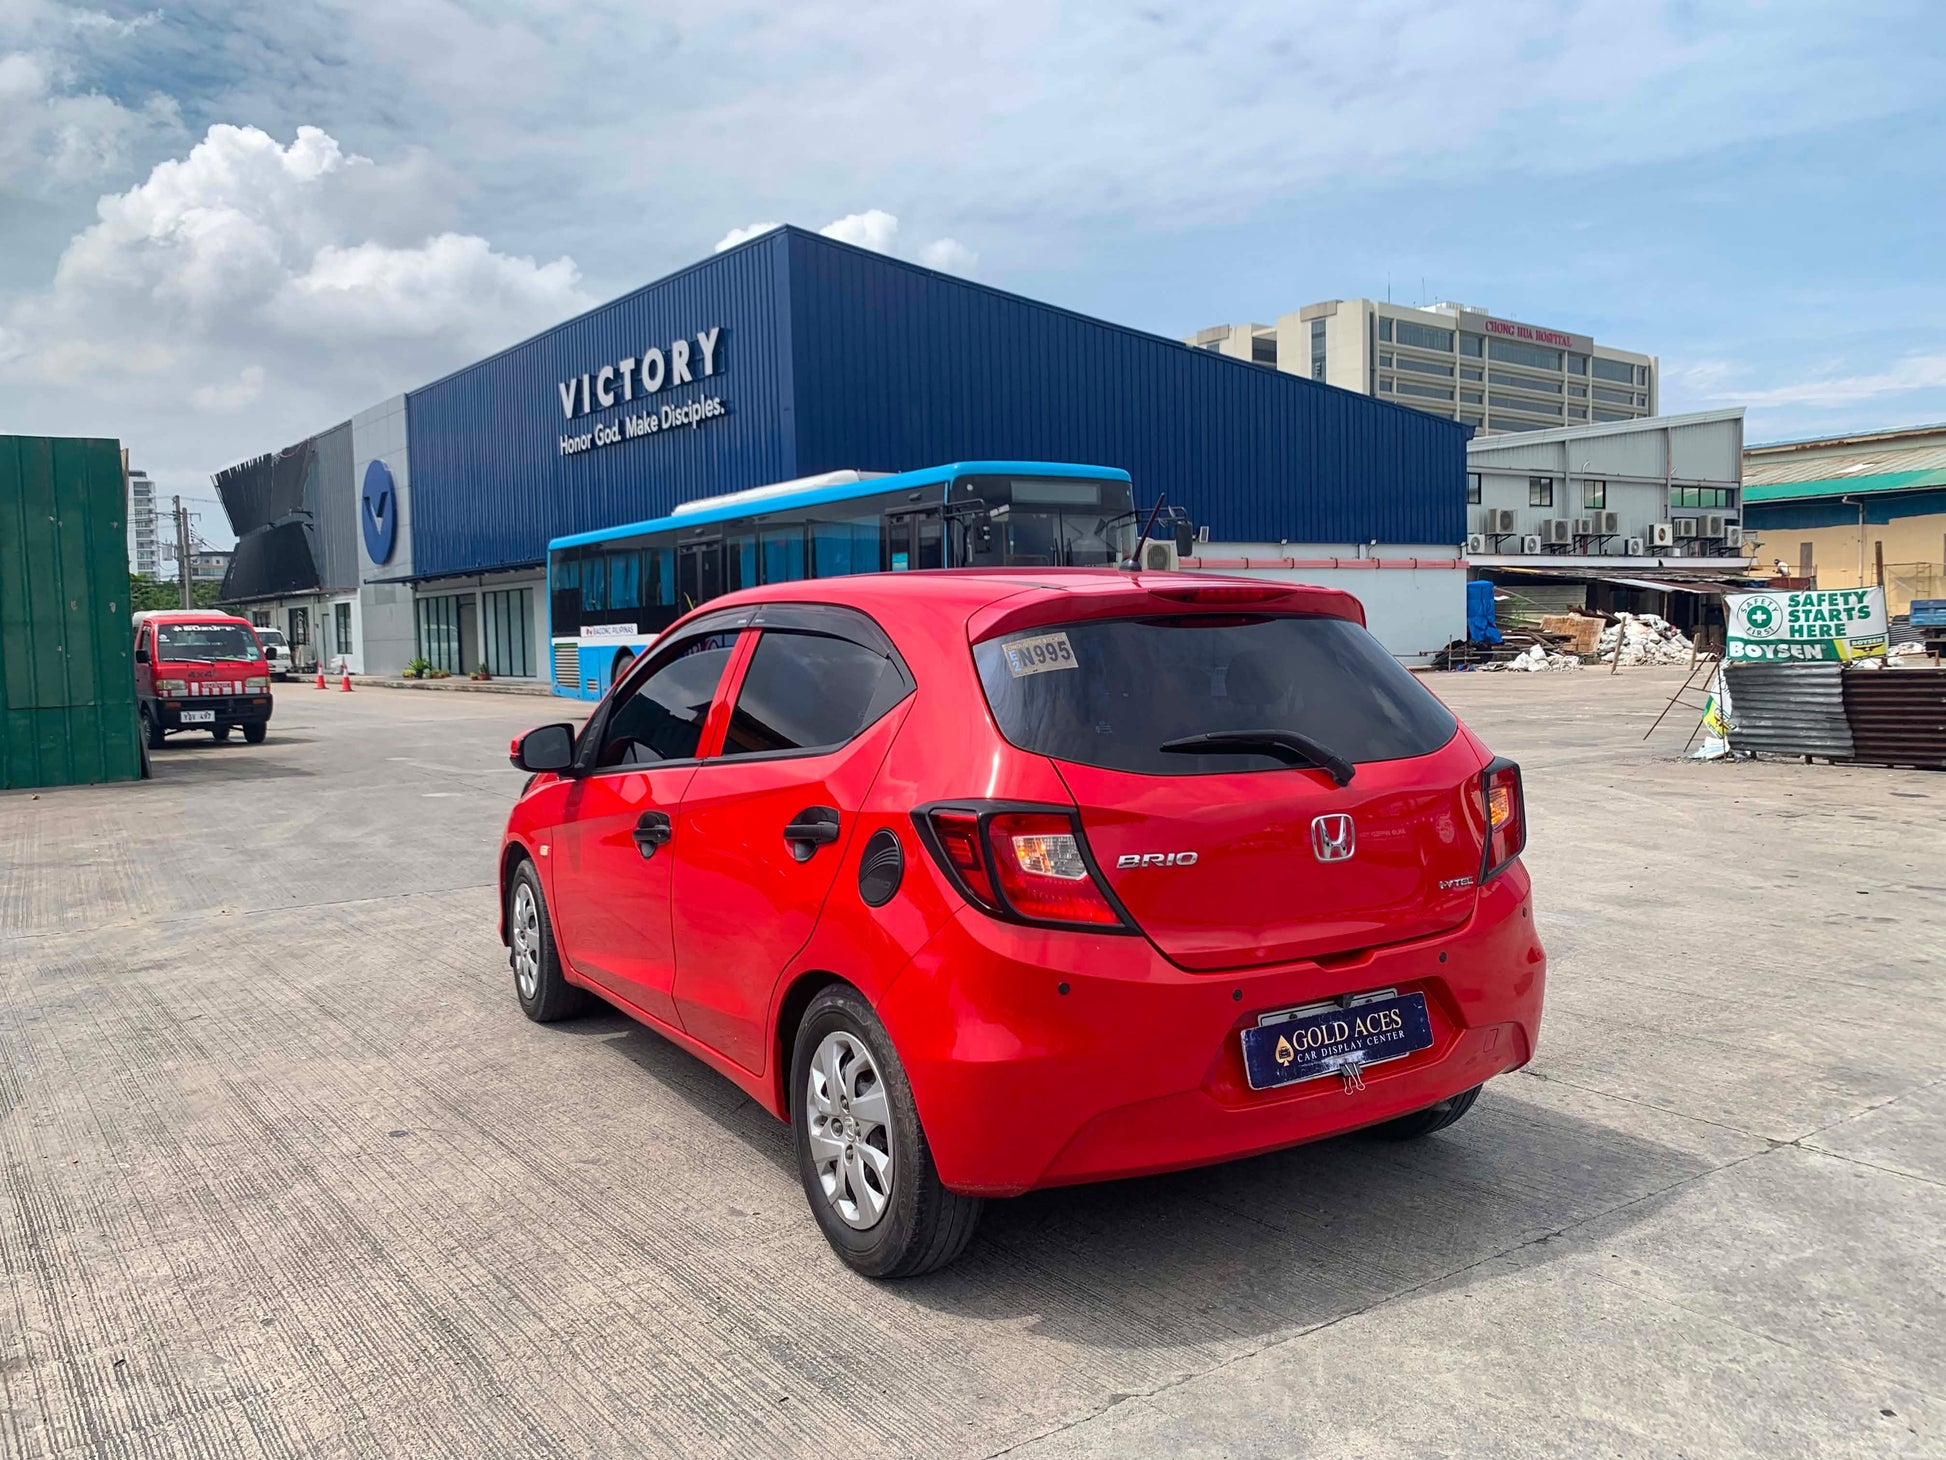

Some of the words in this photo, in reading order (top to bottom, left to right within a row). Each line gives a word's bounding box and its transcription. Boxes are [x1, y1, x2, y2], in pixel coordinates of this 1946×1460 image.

[1485, 320, 1515, 336] CHONG
[1517, 326, 1533, 340] HUA
[1535, 330, 1573, 348] HOSPITAL
[559, 327, 720, 420] VICTORY
[560, 434, 592, 456] Honor
[595, 418, 622, 445] God.
[626, 411, 659, 439] Make
[662, 394, 725, 429] Disciples.
[1741, 598, 1779, 614] SAFETY
[1788, 590, 1868, 608] SAFETY
[1788, 605, 1871, 623] STARTS
[1746, 626, 1775, 636] FIRST
[1789, 624, 1846, 638] HERE
[1852, 637, 1885, 645] BOYSEN
[1019, 640, 1071, 667] N995
[1729, 641, 1824, 660] BOYSEN
[1116, 852, 1198, 869] BRIO
[1292, 1020, 1349, 1051] GOLD
[1354, 1008, 1402, 1037] ACES
[1297, 1051, 1318, 1063] CAR
[1321, 1039, 1363, 1057] DISPLAY
[1366, 1029, 1406, 1047] CENTER
